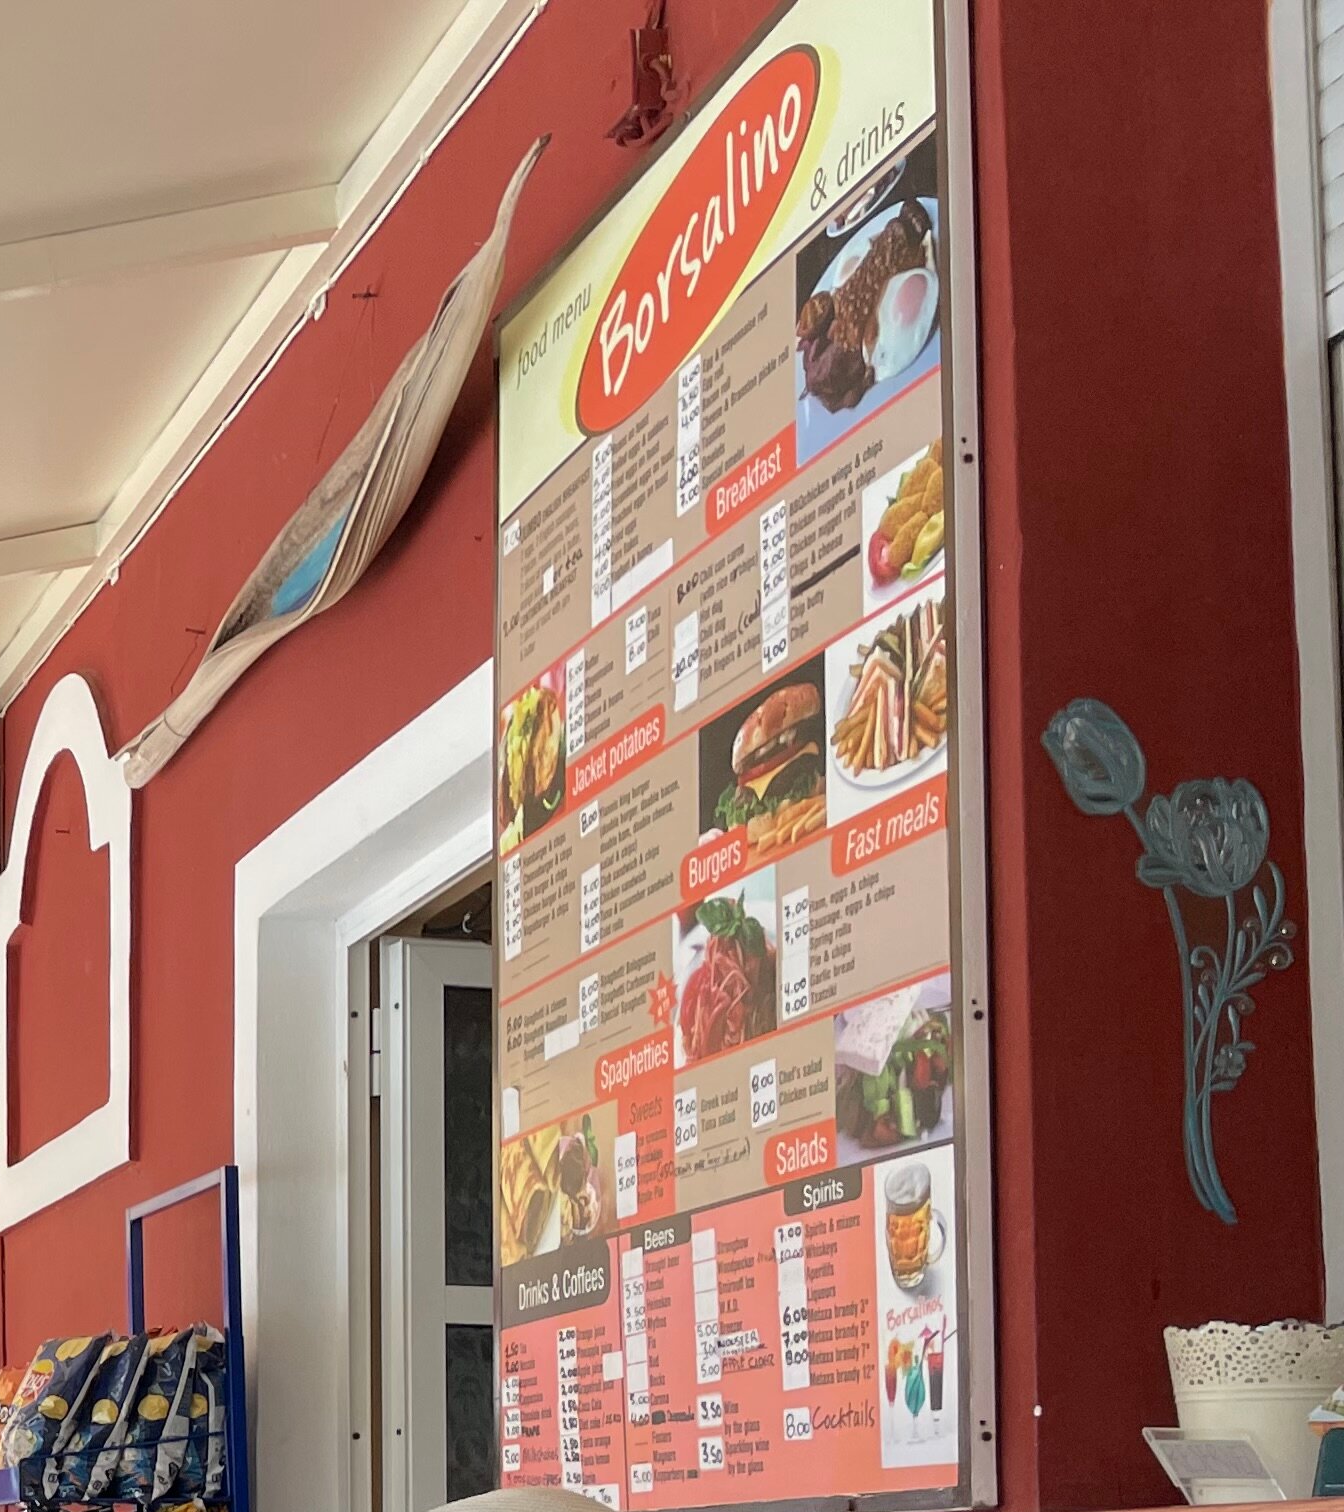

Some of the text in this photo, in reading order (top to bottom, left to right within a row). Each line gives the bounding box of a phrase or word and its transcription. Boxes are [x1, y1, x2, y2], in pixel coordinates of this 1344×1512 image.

[810, 102, 905, 211] & drinks
[600, 84, 801, 396] Borsalino
[517, 283, 592, 390] food menu
[832, 461, 852, 486] wings
[862, 440, 883, 462] chips
[716, 443, 781, 520] Breakfast
[790, 511, 816, 538] Chicken
[818, 493, 846, 520] nuggets
[856, 468, 876, 489] chips
[790, 501, 856, 559] Chicken nugget roll
[790, 558, 809, 579] Chips
[819, 533, 843, 563] cheese
[791, 601, 805, 622] Chip
[721, 627, 737, 647] chips
[744, 632, 761, 654] chips
[790, 621, 809, 642] Chips
[573, 717, 659, 796] Jacket potatoes
[846, 792, 939, 864] Fast meals
[688, 837, 741, 888] Burgers
[830, 887, 848, 903] eggs
[850, 881, 856, 894] &
[859, 872, 880, 891] chips
[845, 900, 863, 917] eggs
[865, 893, 871, 907] &
[874, 884, 895, 903] chips
[810, 923, 851, 951] Spring rolls
[824, 949, 829, 962] &
[832, 943, 851, 959] chips
[811, 958, 855, 986] Garlic bread
[601, 1040, 669, 1092] Spaghetties
[779, 1057, 822, 1085] Chef's salad
[701, 1087, 738, 1112] Greek salad
[779, 1078, 829, 1105] Chicken salad
[630, 1096, 662, 1125] Sweets
[701, 1110, 736, 1133] Tuna salad
[776, 1132, 828, 1175] Salads
[803, 1182, 844, 1209] Spirits
[778, 1225, 802, 1243] 7.00
[837, 1214, 860, 1230] mixers
[644, 1228, 675, 1250] Beers
[519, 1265, 605, 1310] Drinks & Coffees
[783, 1307, 807, 1326] 6.00
[834, 1301, 858, 1320] brandy
[887, 1295, 943, 1330] Borsalinos
[835, 1323, 859, 1342] brandy
[835, 1345, 860, 1364] brandy
[810, 1367, 860, 1385] Metaxa brandy
[745, 1420, 760, 1435] glass
[813, 1400, 875, 1430] Cocktails
[725, 1440, 769, 1455] Sparkling wine
[748, 1461, 764, 1475] glass
